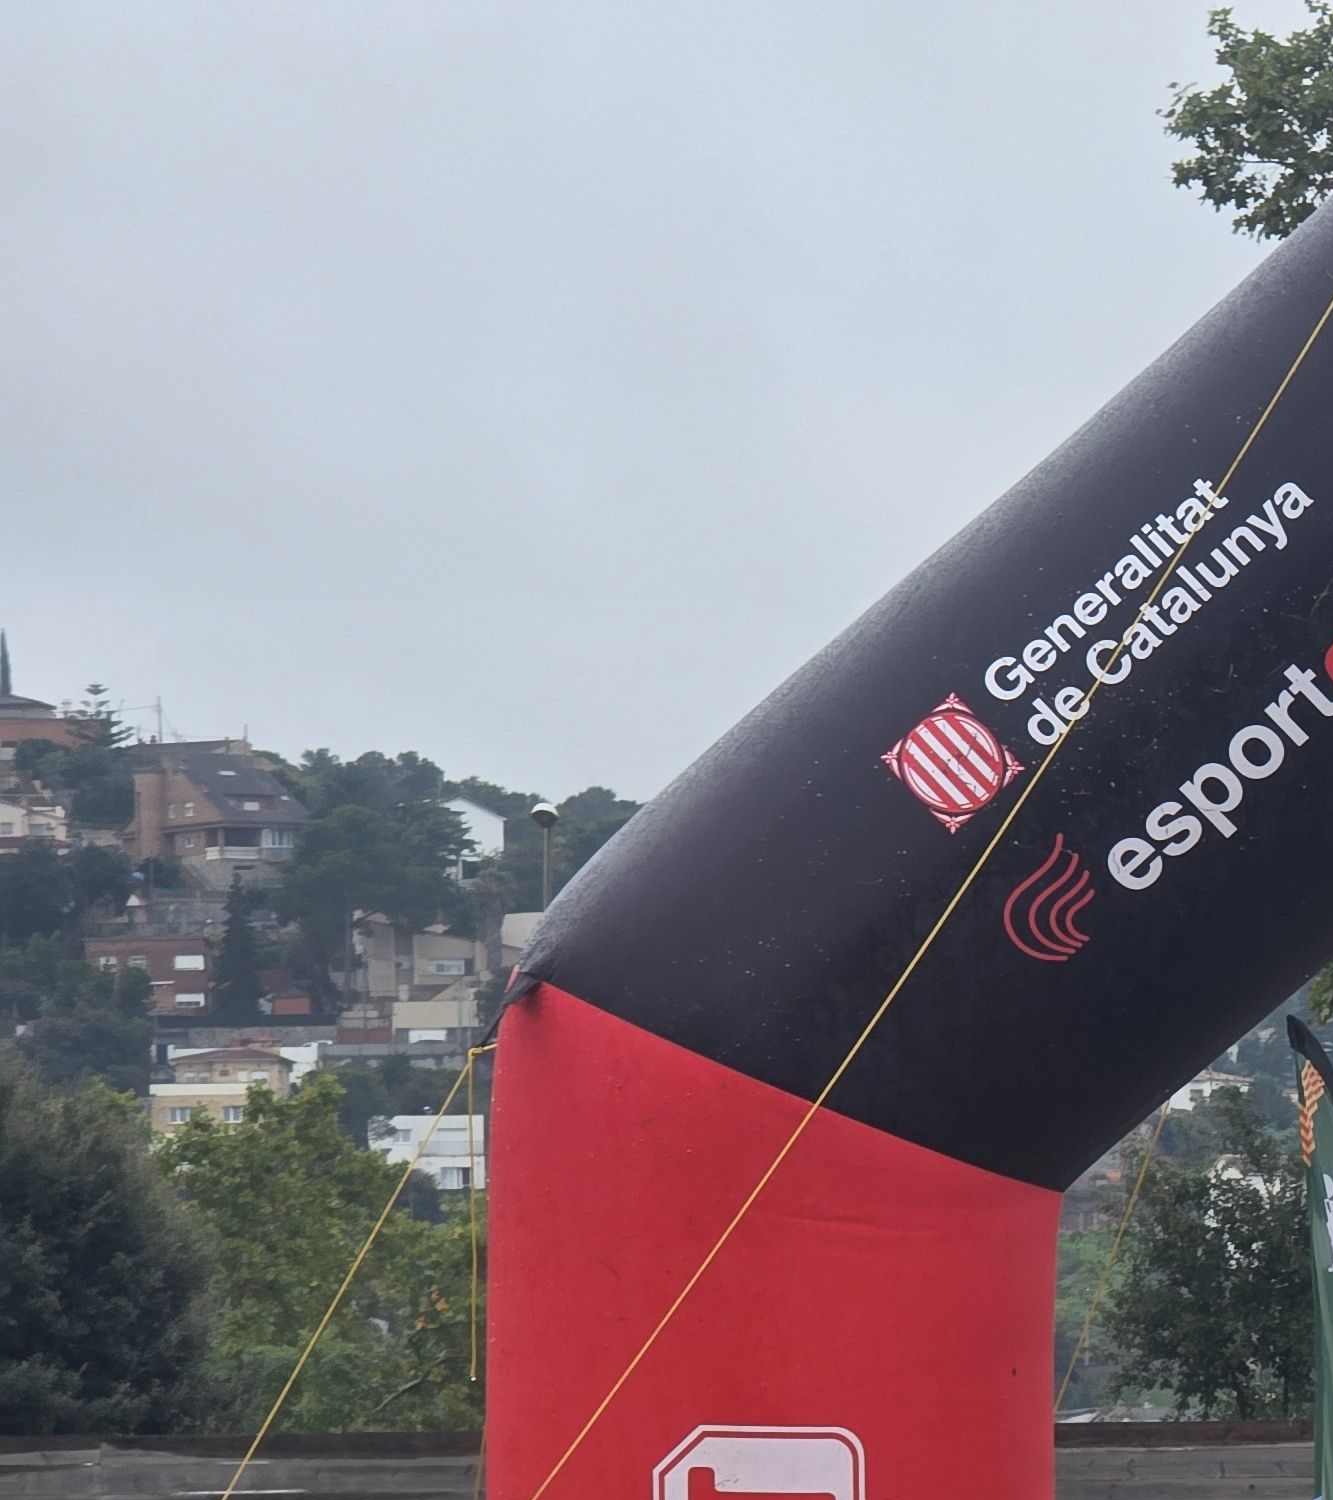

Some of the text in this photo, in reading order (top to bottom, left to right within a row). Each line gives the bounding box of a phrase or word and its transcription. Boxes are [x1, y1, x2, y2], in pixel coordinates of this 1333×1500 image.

[984, 478, 1229, 701] Generalitat
[1027, 480, 1314, 747] de Catalunya
